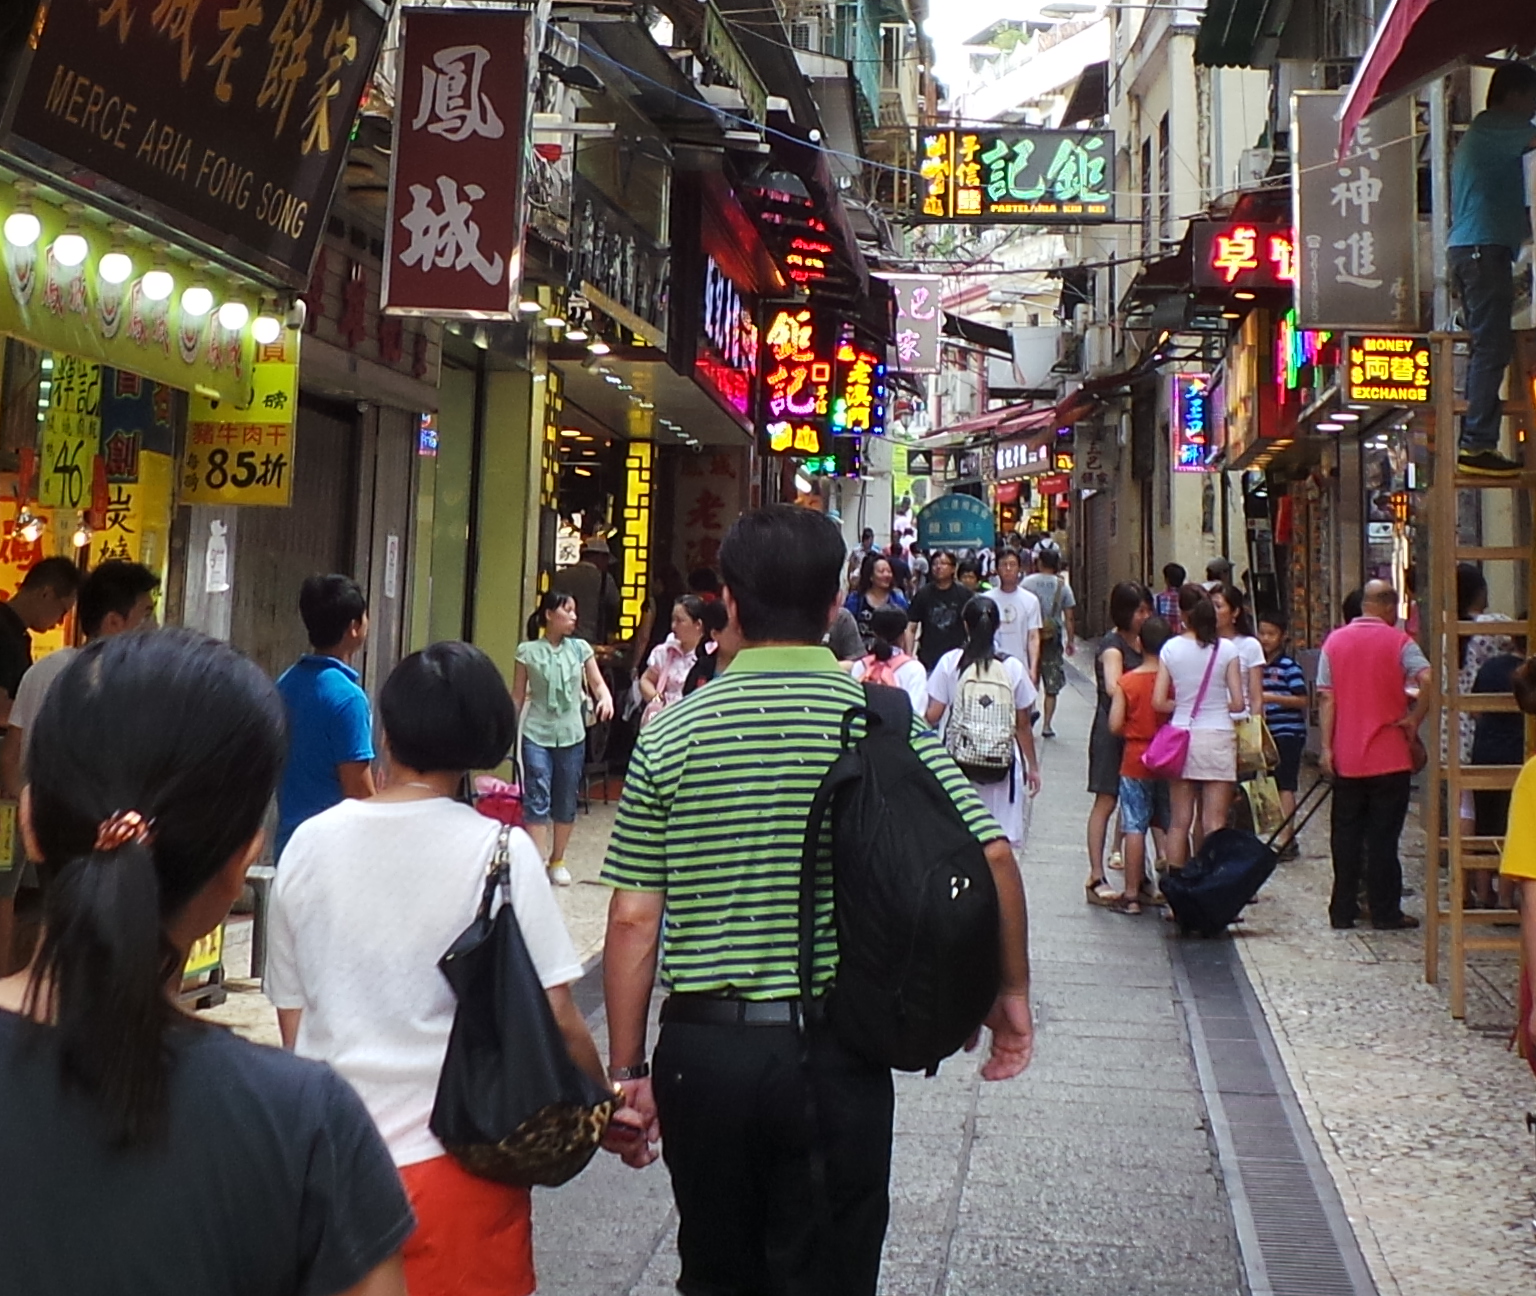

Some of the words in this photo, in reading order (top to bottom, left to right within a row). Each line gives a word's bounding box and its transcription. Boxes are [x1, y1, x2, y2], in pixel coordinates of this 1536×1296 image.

[44, 64, 129, 152] MERCE
[136, 120, 190, 176] ARIA
[199, 150, 251, 207] FONG
[255, 181, 309, 240] SONG
[398, 44, 506, 286] 鳳城
[1364, 338, 1413, 352] MONEY
[1352, 386, 1427, 401] EXCHANGE
